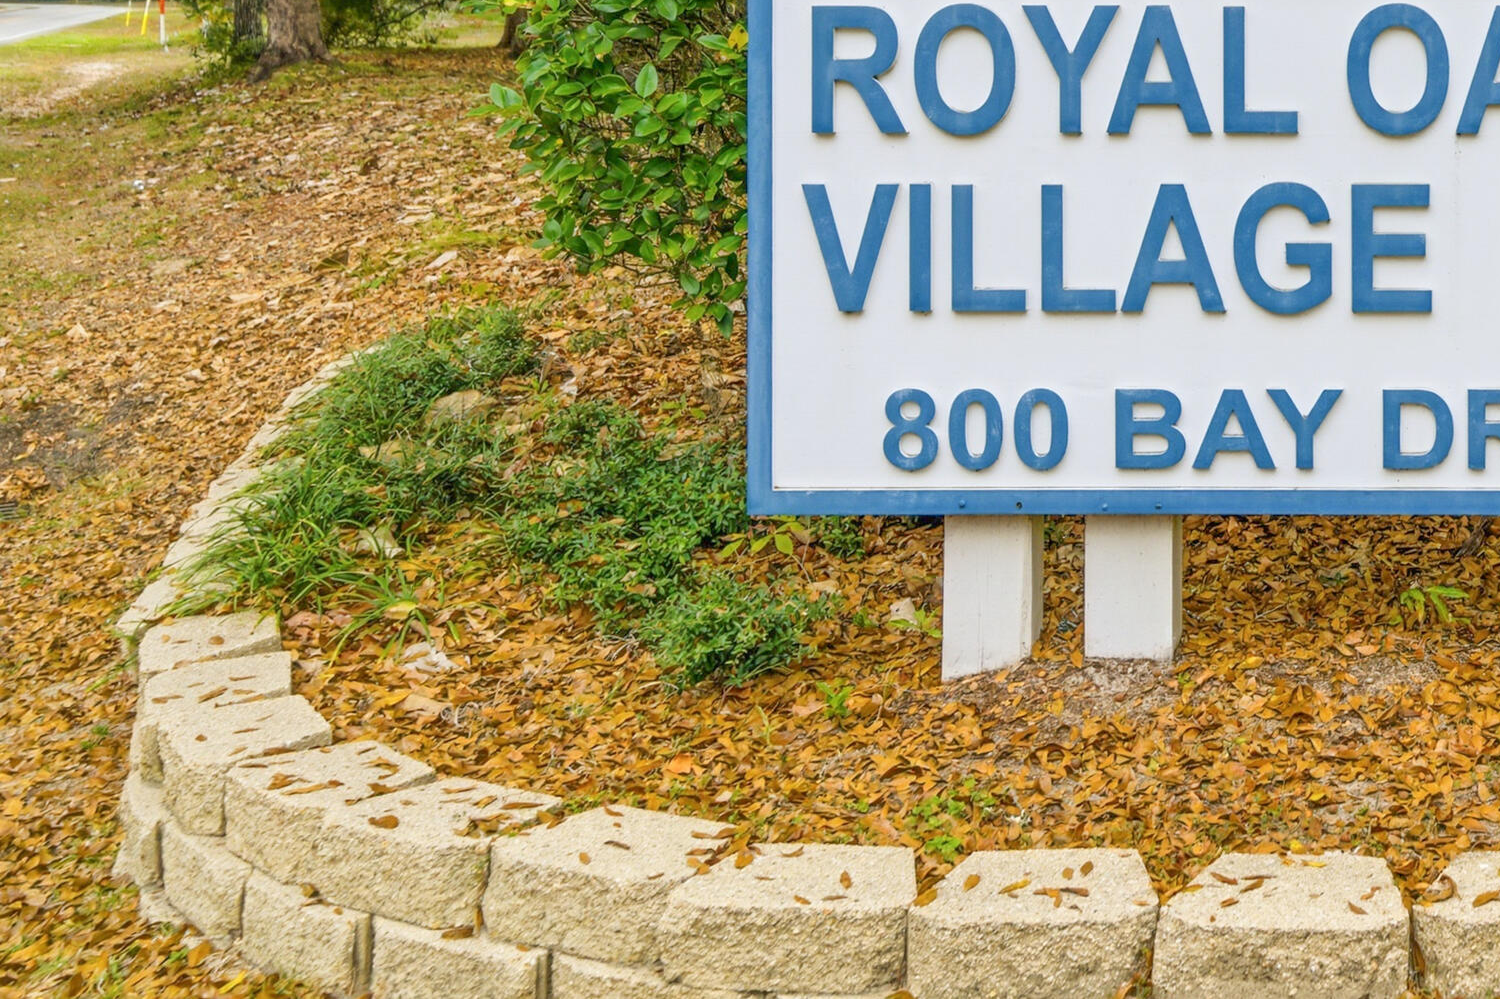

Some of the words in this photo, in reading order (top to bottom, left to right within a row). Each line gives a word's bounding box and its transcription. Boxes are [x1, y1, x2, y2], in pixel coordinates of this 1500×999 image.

[811, 3, 1300, 138] ROYAL
[801, 182, 1433, 315] VILLAGE
[882, 387, 1071, 471] 800
[1114, 387, 1345, 470] BAY
